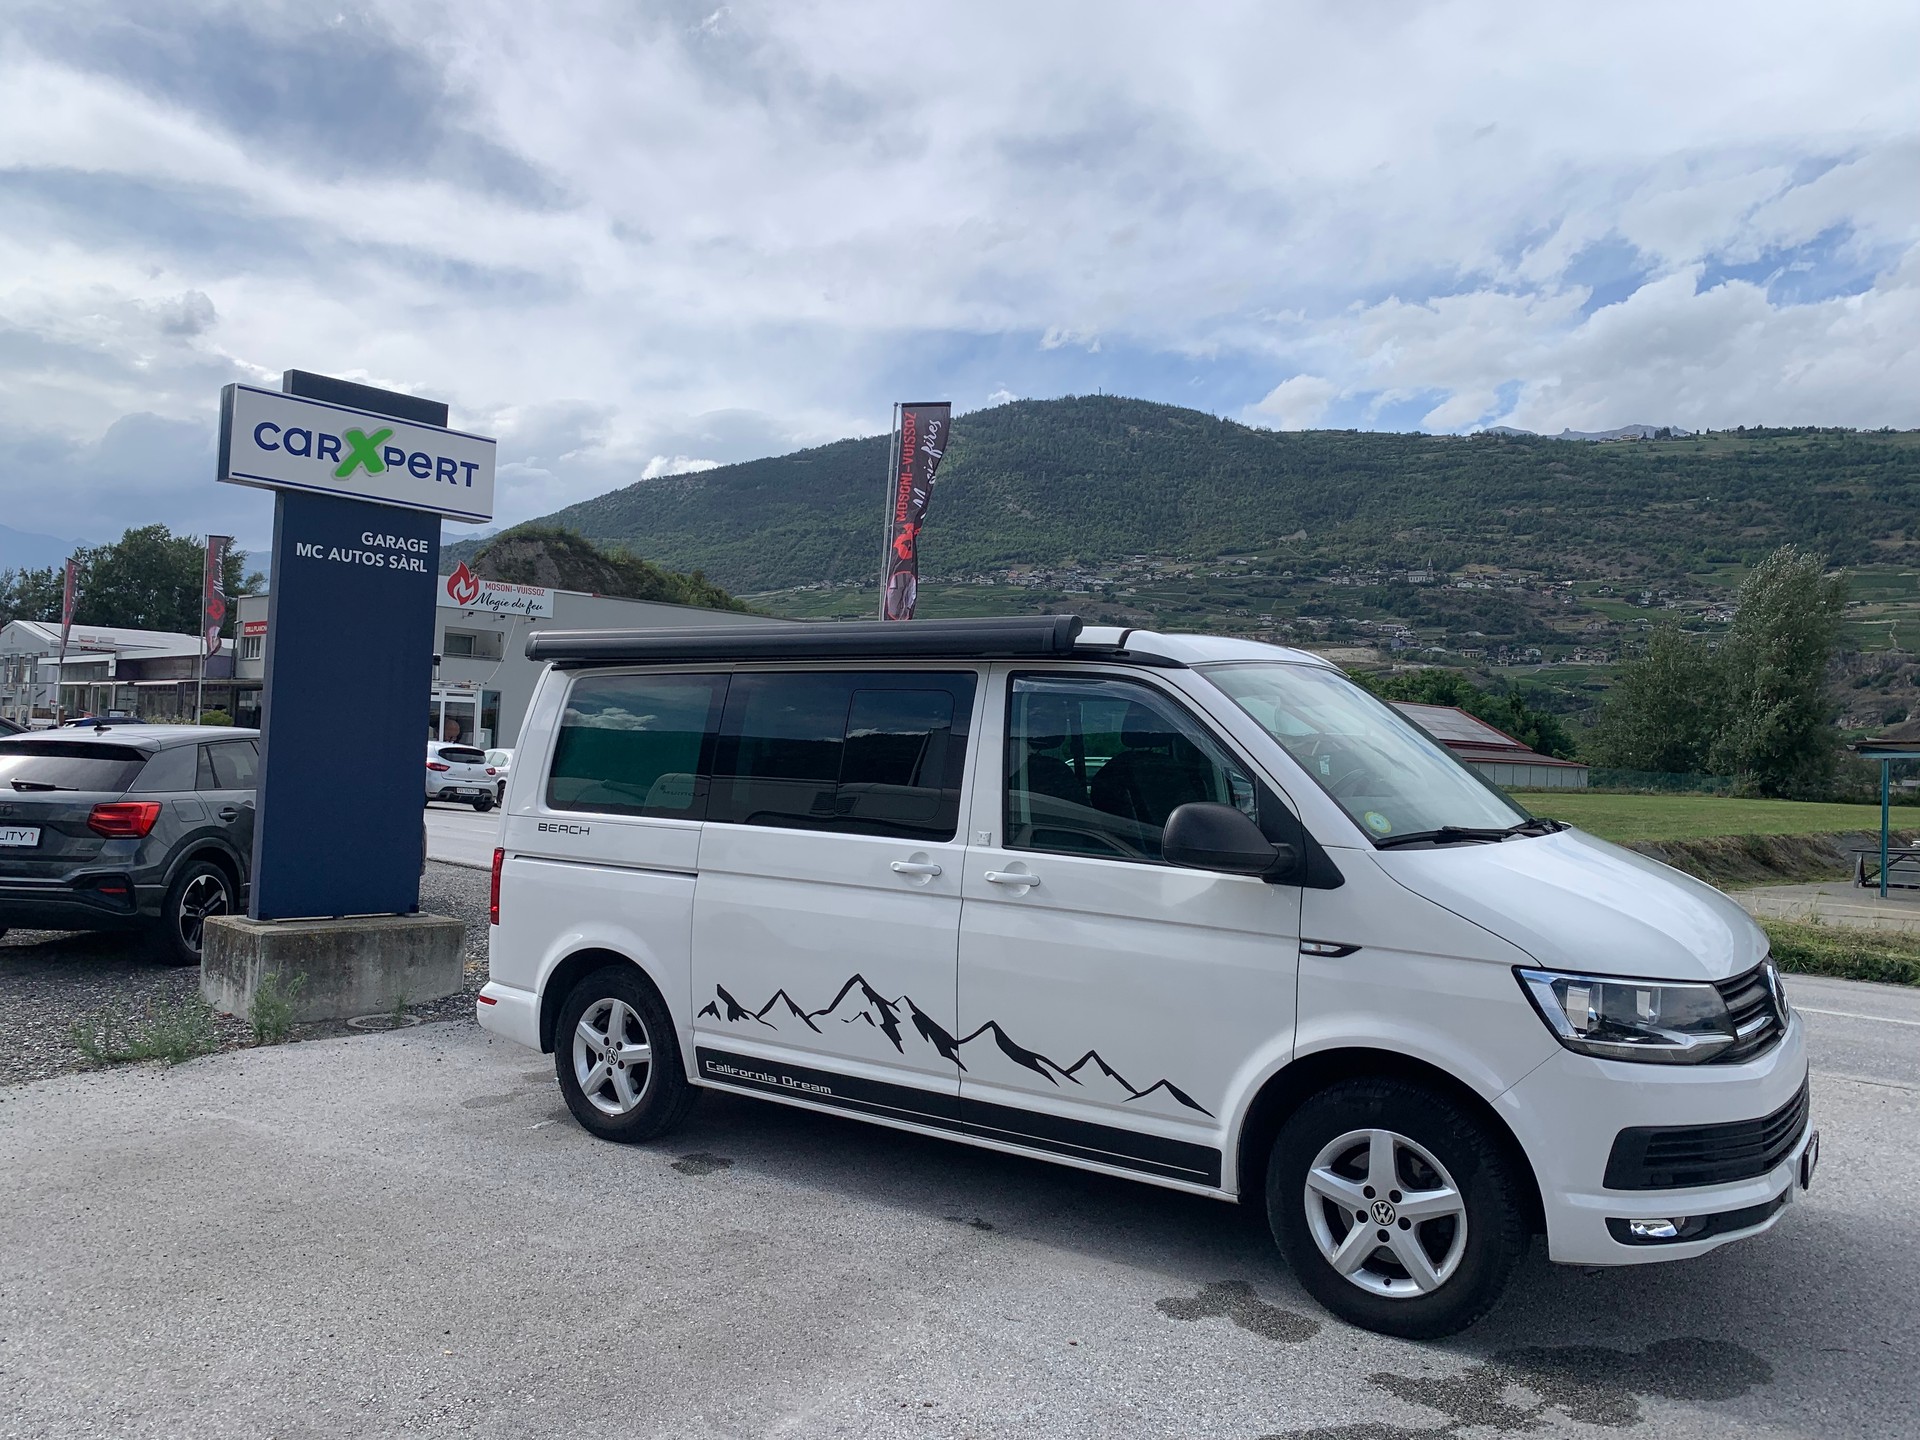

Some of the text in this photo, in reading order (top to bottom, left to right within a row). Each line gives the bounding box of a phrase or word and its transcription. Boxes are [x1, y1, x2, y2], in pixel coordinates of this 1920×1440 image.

[896, 412, 917, 522] MOSONI-VUISSOZ
[361, 531, 429, 554] GARAGE
[296, 542, 428, 573] MC AUTOS SÀRL
[485, 582, 545, 596] MOSONI-VUISSOZ
[471, 592, 543, 615] Magie du feu
[537, 822, 591, 836] BEACH
[705, 1060, 832, 1095] California Dream
